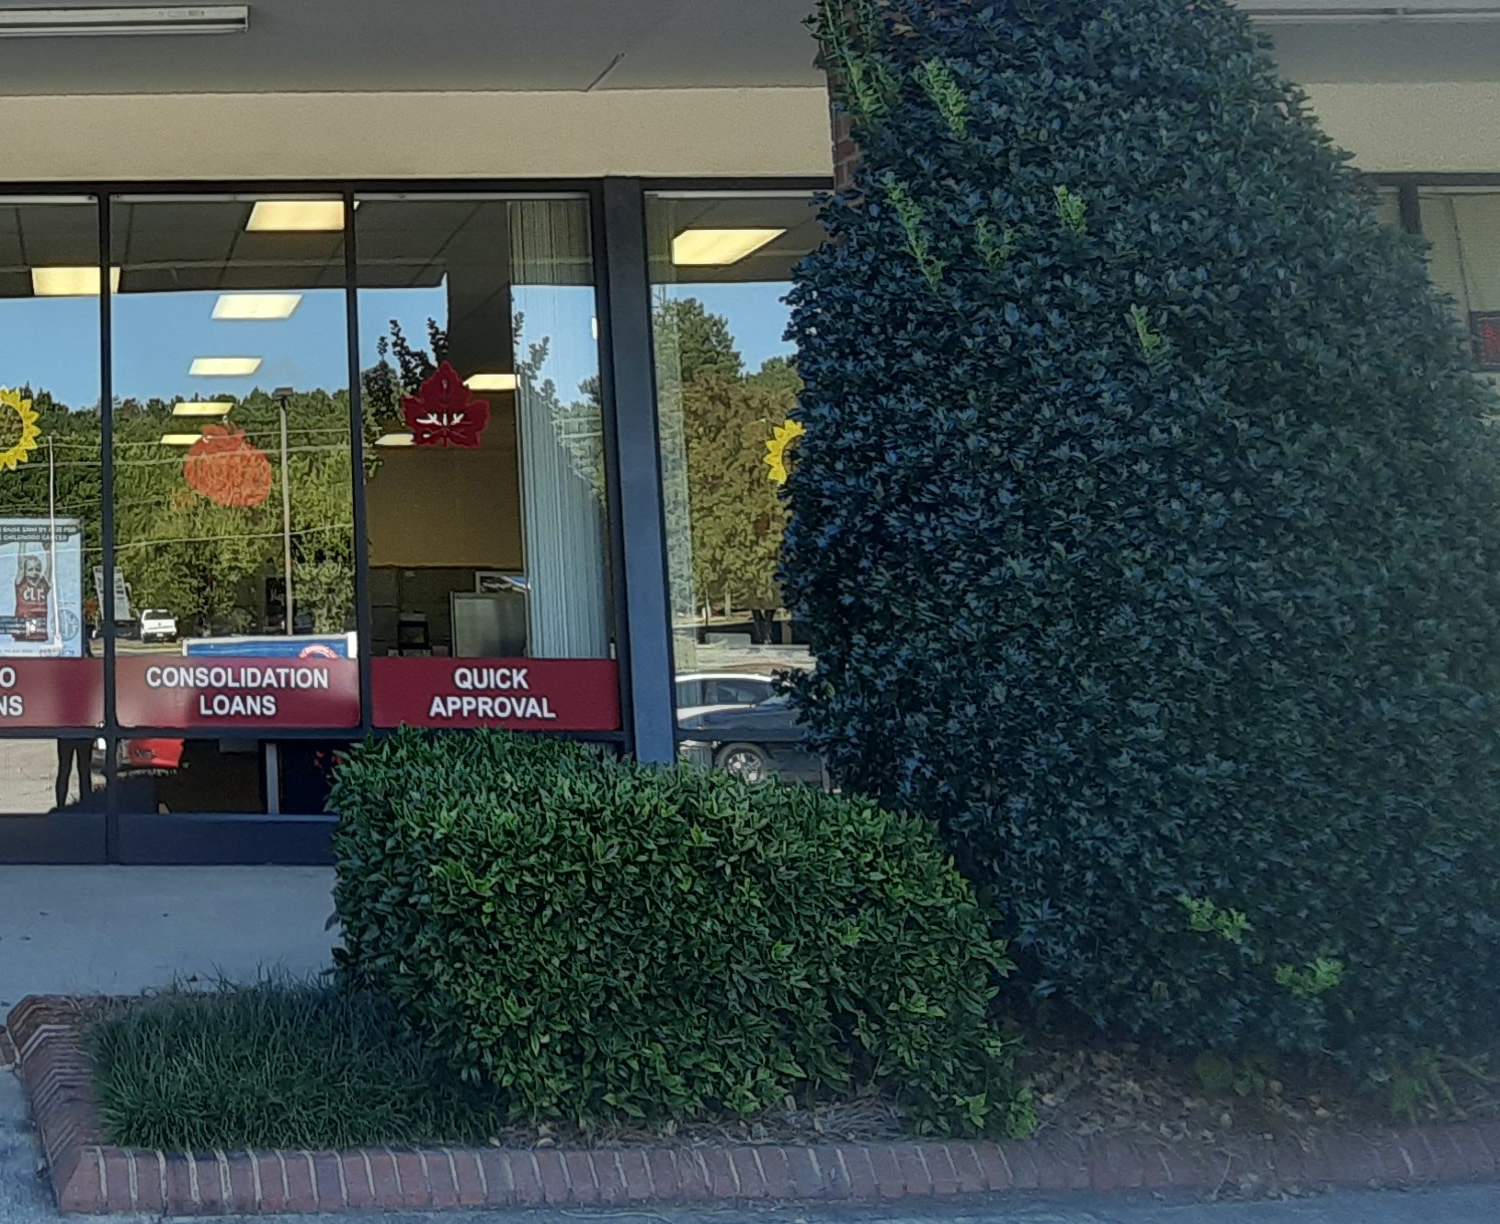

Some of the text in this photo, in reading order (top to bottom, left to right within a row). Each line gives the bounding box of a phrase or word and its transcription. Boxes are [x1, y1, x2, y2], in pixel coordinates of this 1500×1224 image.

[145, 666, 329, 689] CONSOLIDATION
[453, 668, 529, 691] QUICK
[199, 695, 277, 716] LOANS
[429, 696, 557, 719] APPROVAL
